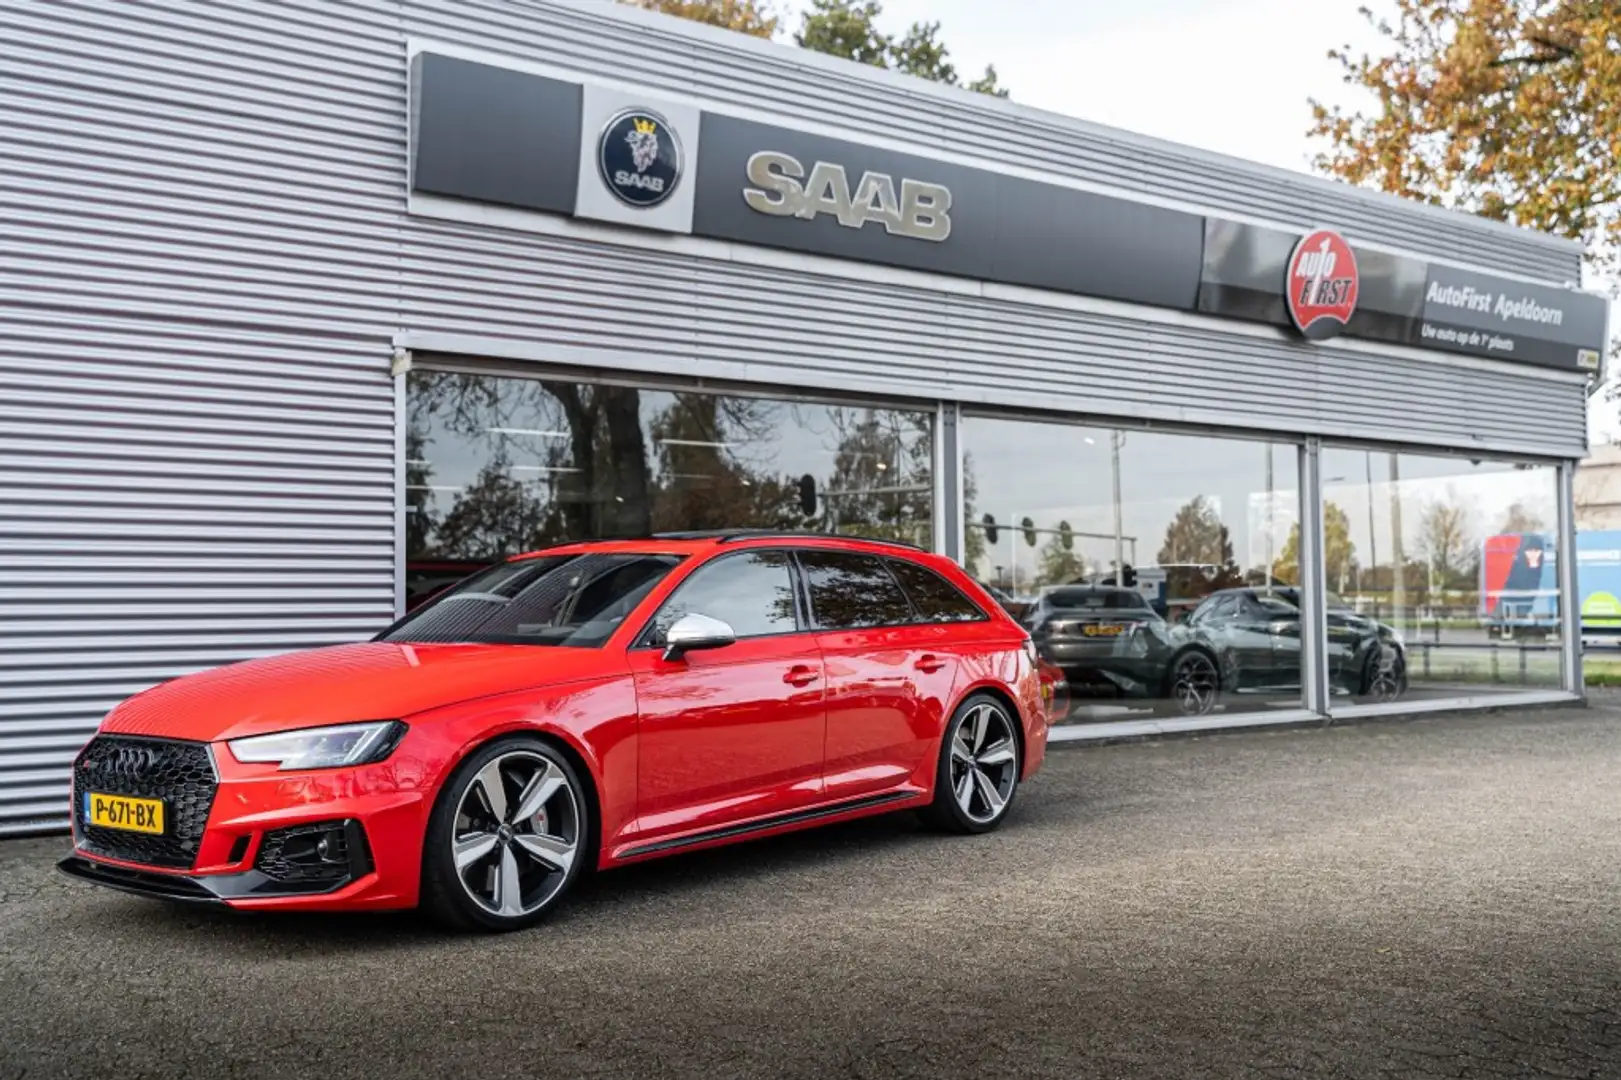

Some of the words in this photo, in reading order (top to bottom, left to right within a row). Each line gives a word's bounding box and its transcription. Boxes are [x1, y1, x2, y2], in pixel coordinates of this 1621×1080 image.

[615, 170, 664, 192] SAAB
[743, 151, 952, 241] SAAB
[1426, 281, 1492, 313] AutoFirst
[1494, 293, 1563, 326] Apeldoorn
[96, 798, 156, 828] P-671-BX
